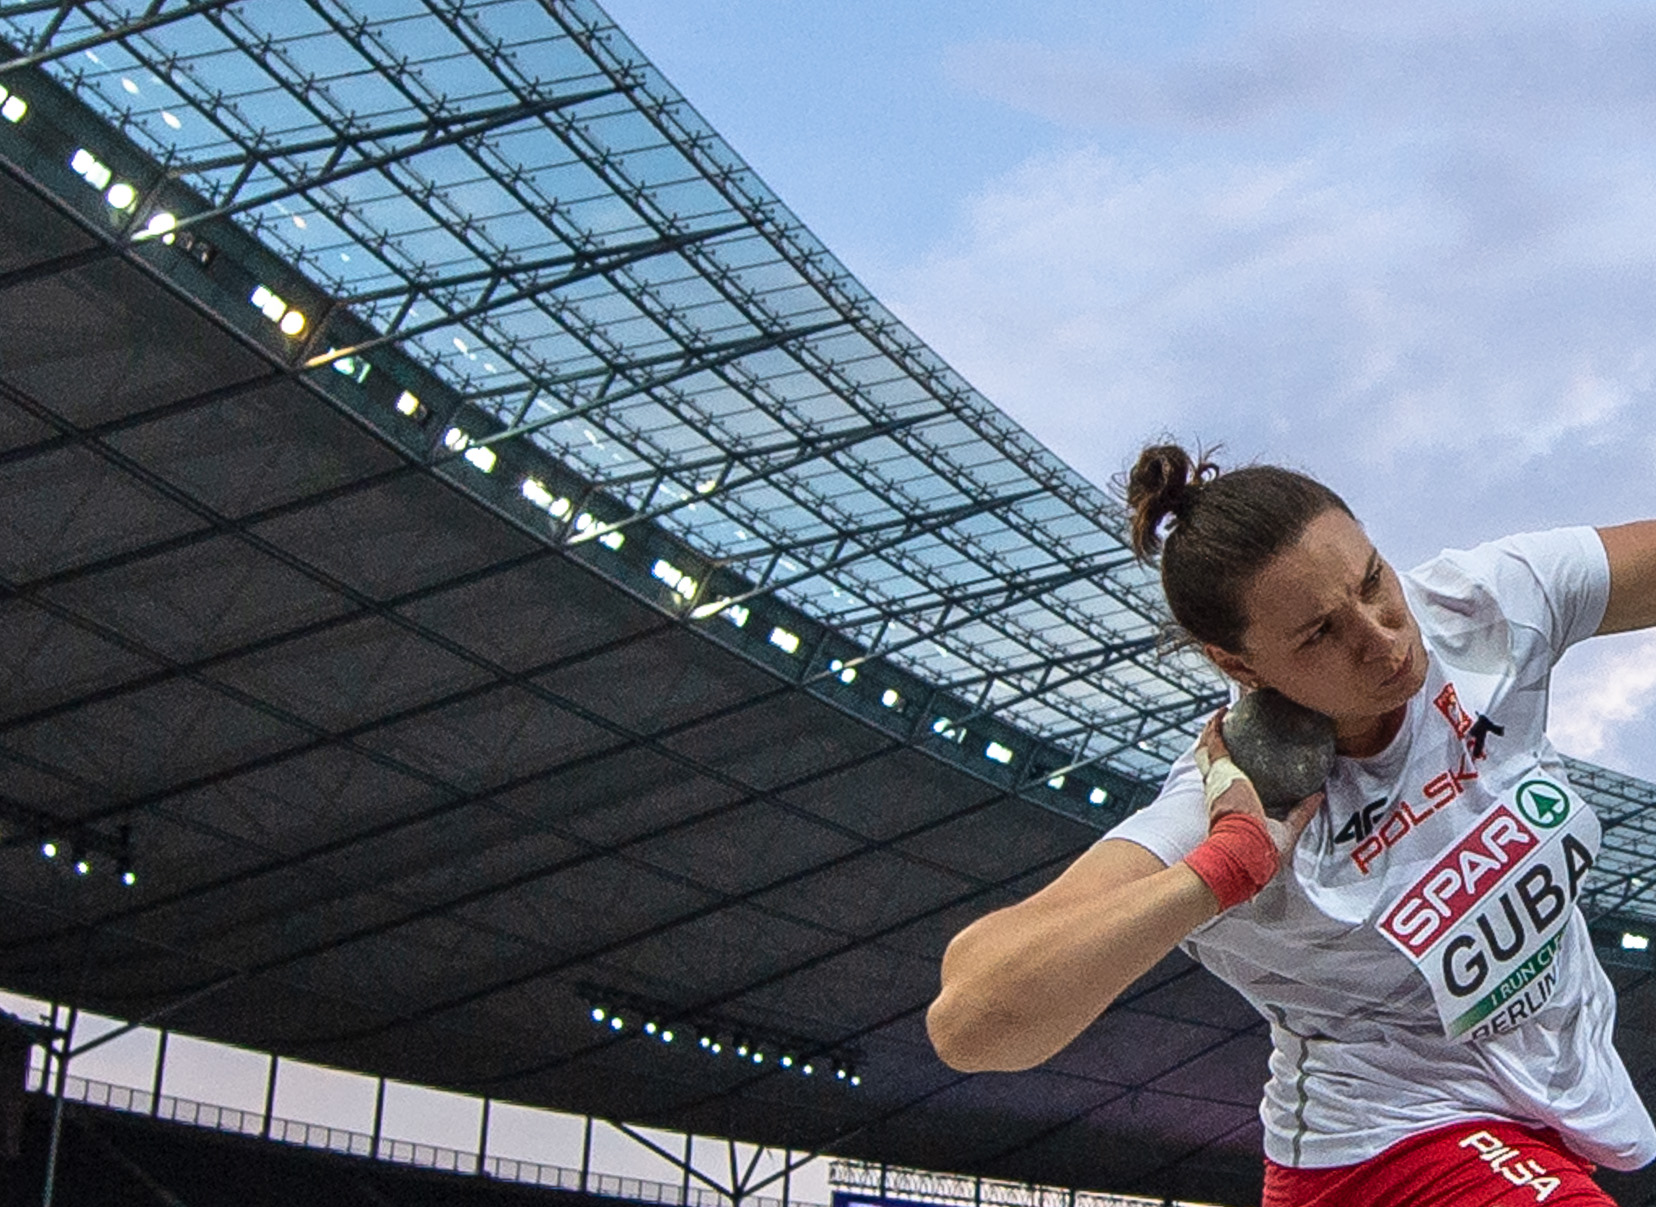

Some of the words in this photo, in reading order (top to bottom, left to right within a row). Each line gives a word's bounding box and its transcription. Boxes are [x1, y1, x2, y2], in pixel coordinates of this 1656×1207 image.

[1334, 797, 1388, 844] 4F
[1392, 815, 1530, 947] SPAR
[1442, 833, 1594, 998] GUBA
[1500, 961, 1536, 999] RUN
